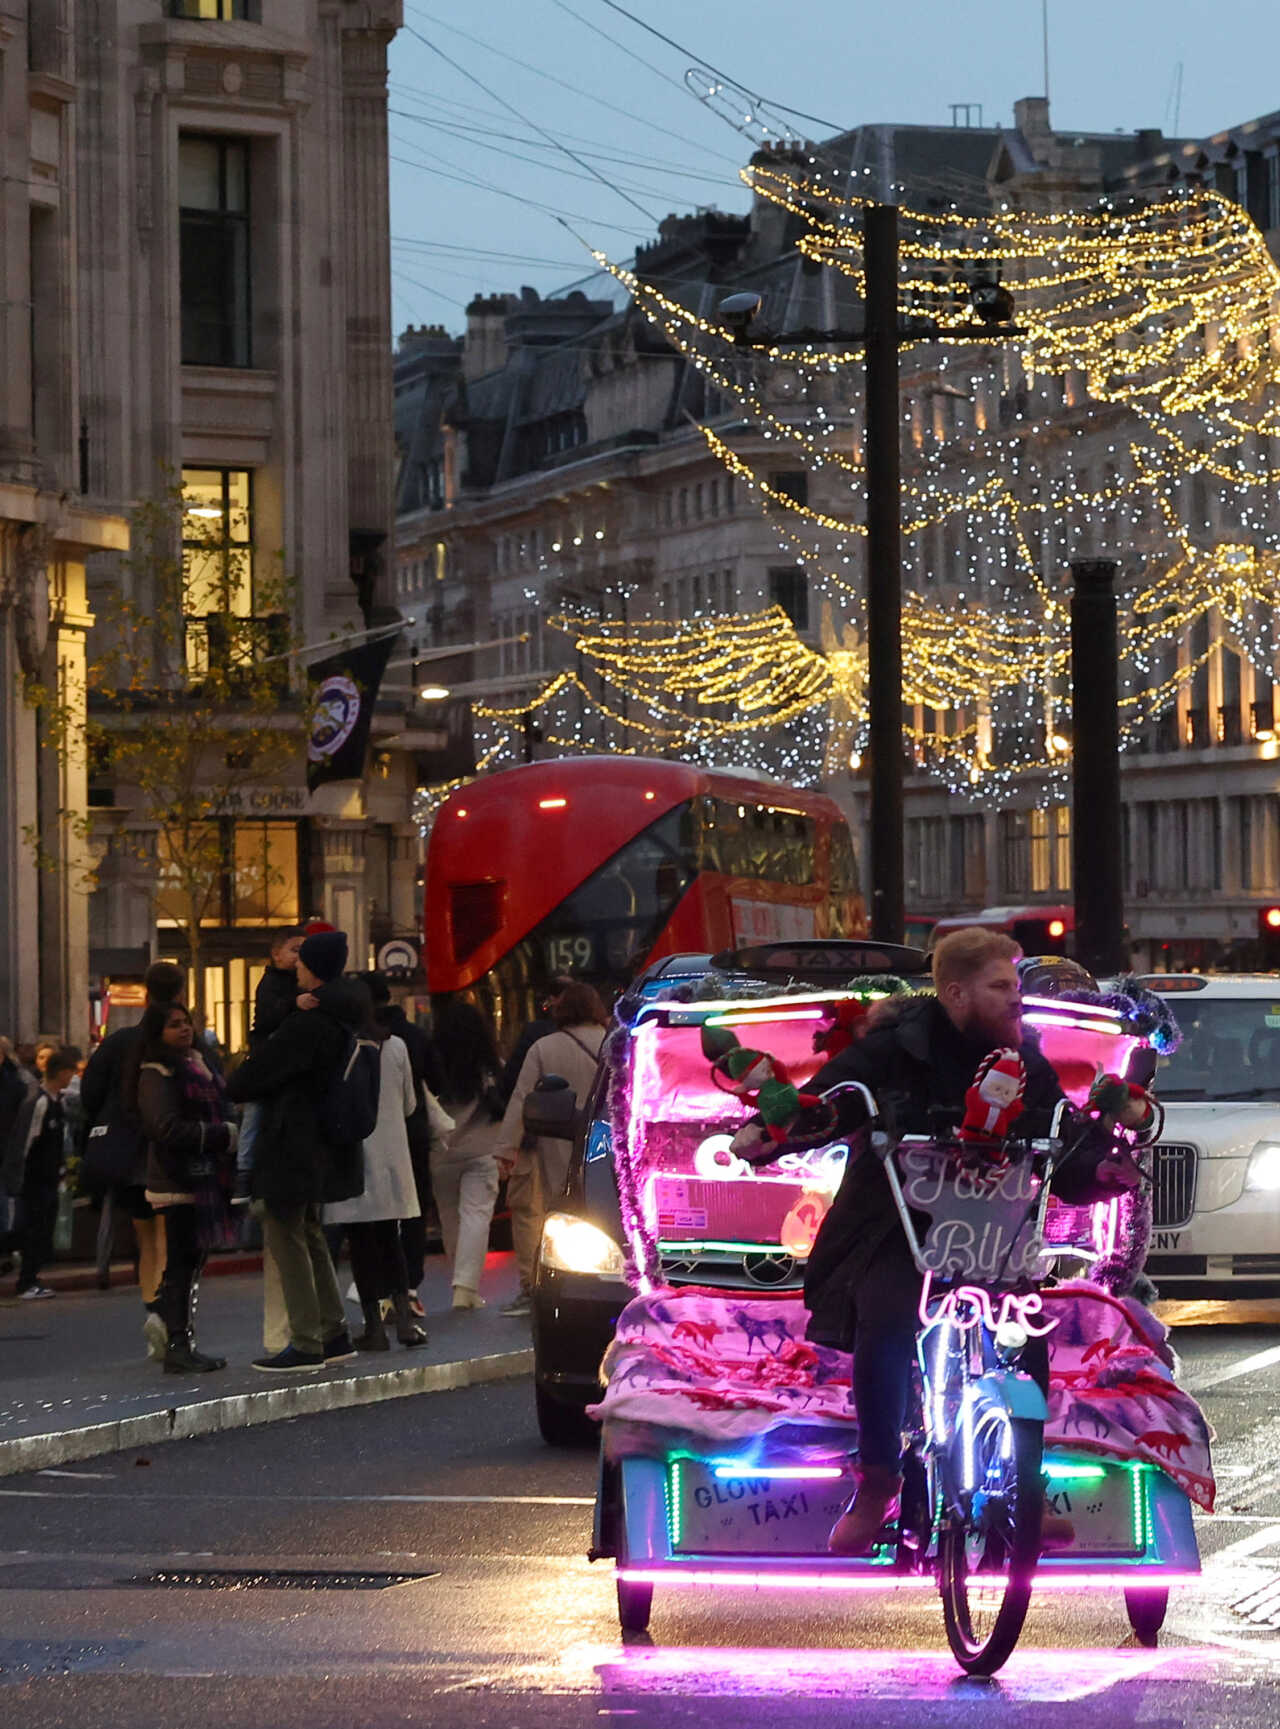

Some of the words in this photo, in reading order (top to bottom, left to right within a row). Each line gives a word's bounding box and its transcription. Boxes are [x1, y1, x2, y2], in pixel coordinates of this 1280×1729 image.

[549, 936, 592, 971] 159
[792, 951, 867, 969] TAXI
[694, 1478, 771, 1509] GLOW
[747, 1491, 809, 1526] TAXI
